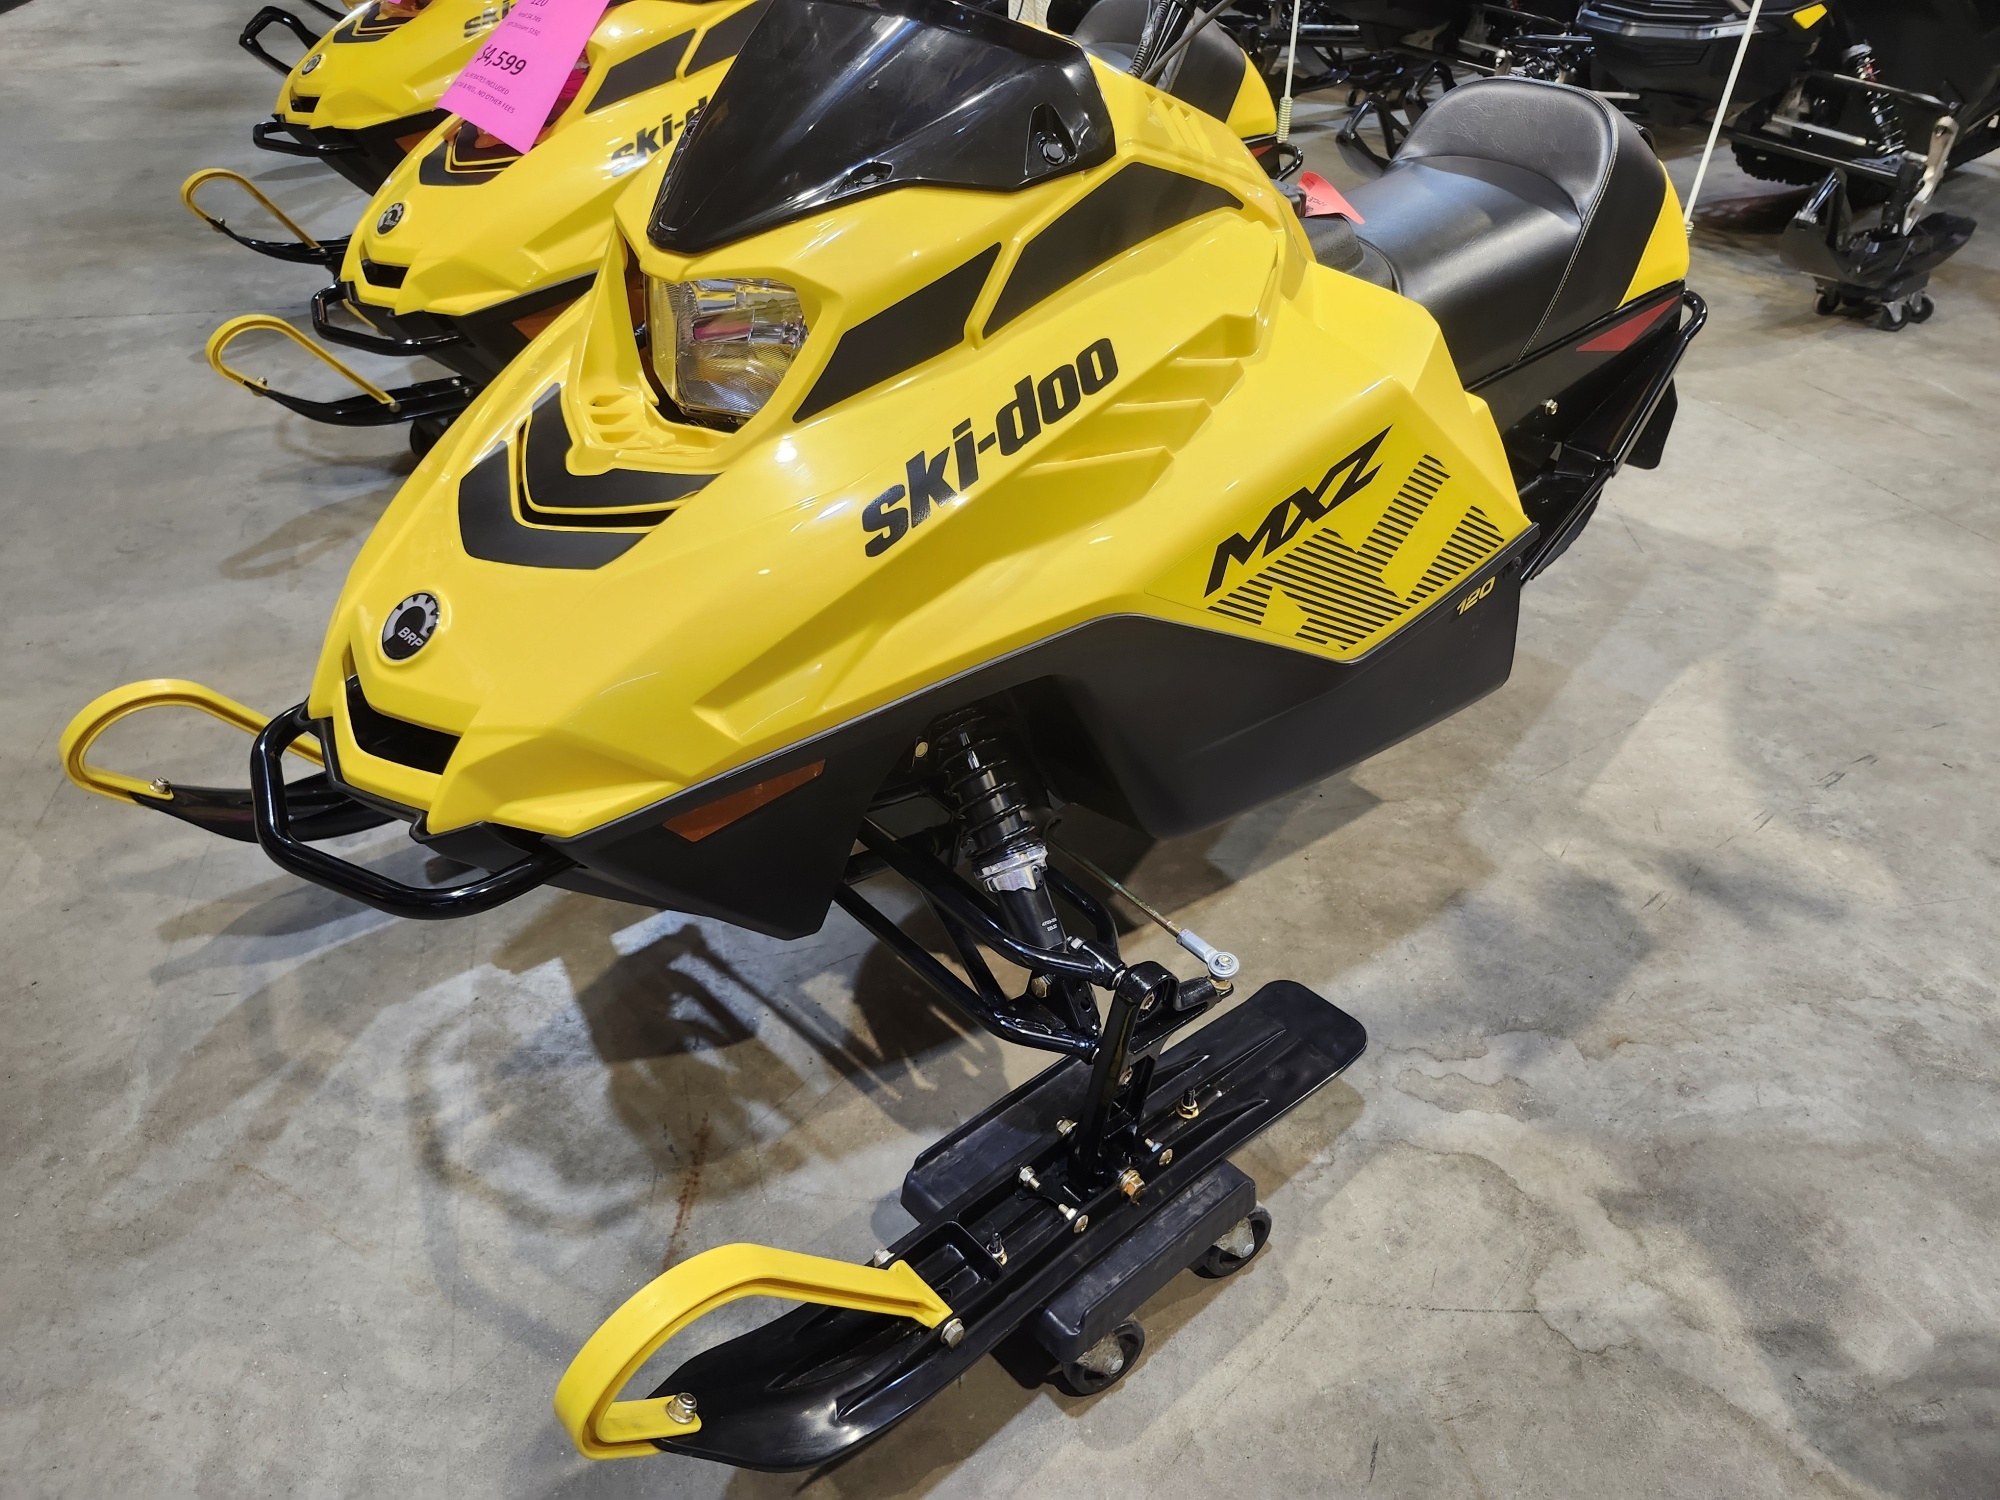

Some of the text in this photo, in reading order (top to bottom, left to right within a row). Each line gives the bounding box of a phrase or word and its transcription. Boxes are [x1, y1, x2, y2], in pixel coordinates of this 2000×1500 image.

[474, 44, 527, 76] $4,599
[485, 80, 510, 95] INCLUDED
[485, 94, 502, 106] OTHER
[501, 102, 516, 114] FEES
[862, 338, 1119, 558] ski-doo
[1203, 423, 1394, 598] MXZ
[1456, 575, 1496, 616] 120
[397, 626, 425, 648] BRP
